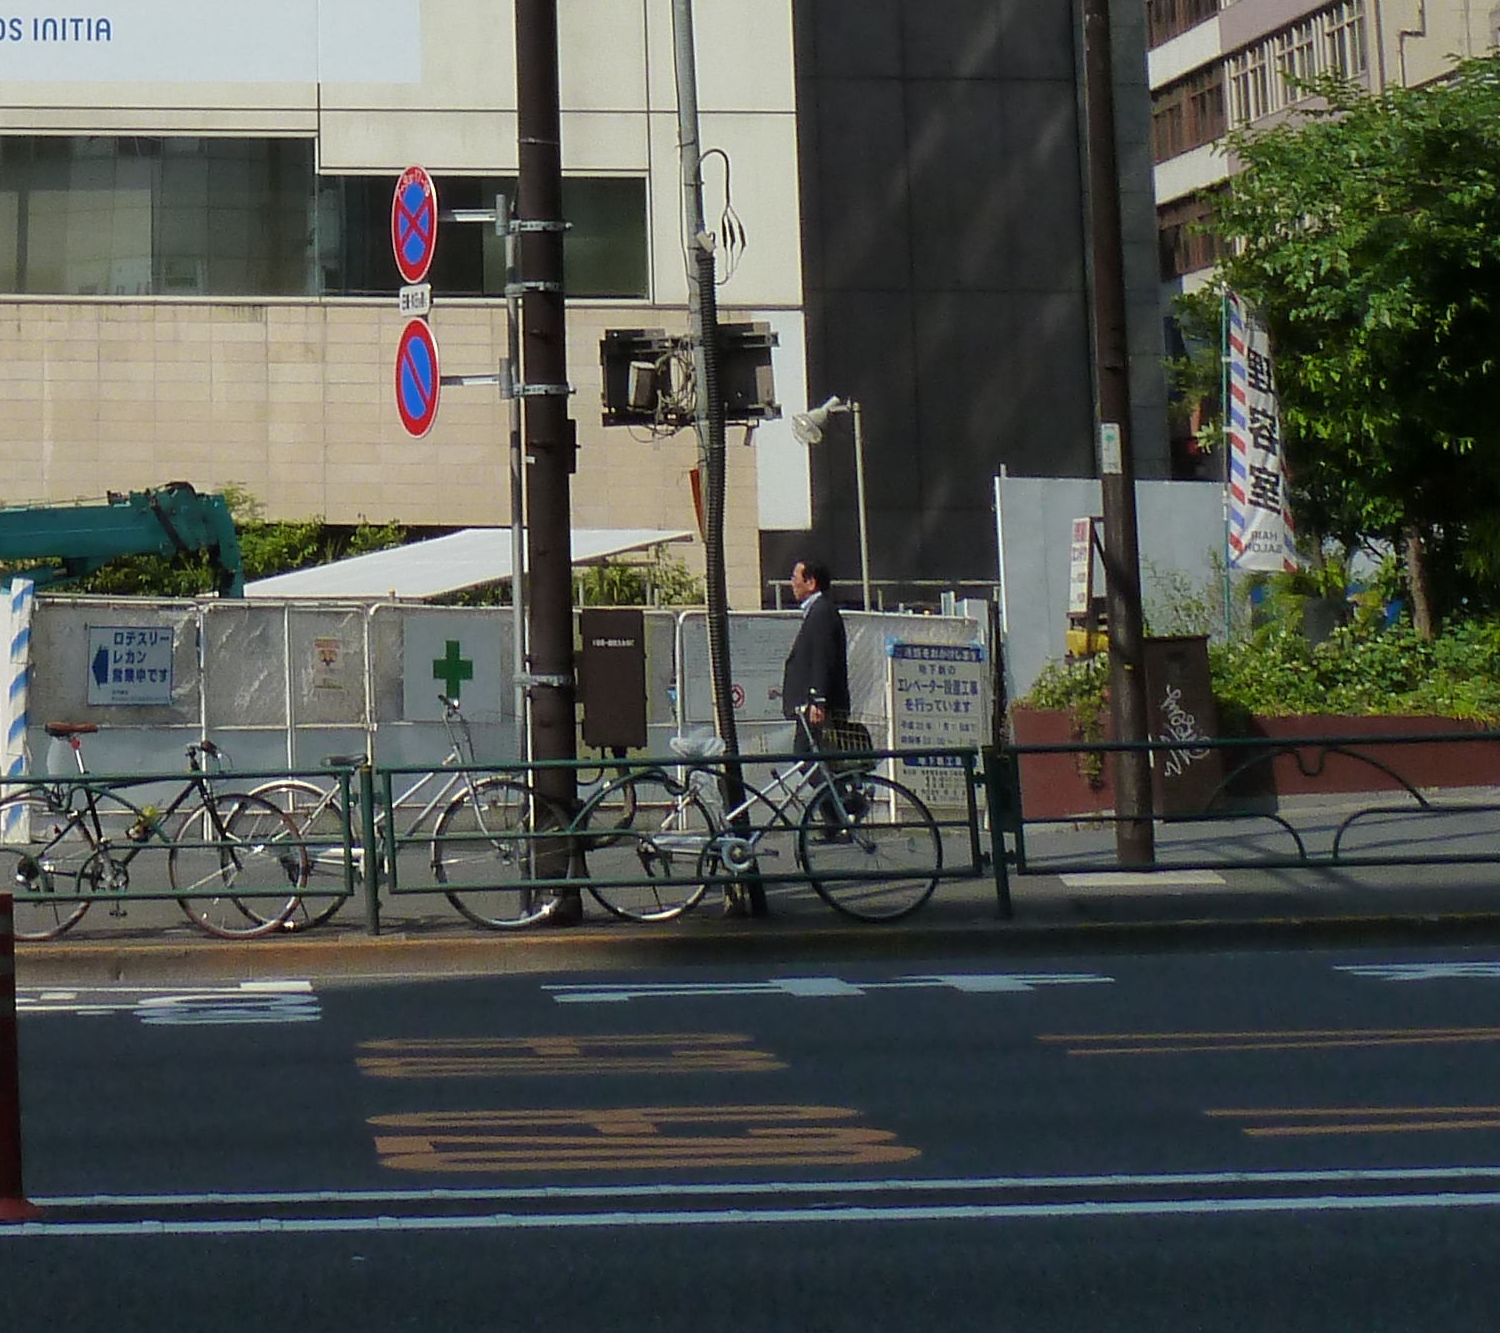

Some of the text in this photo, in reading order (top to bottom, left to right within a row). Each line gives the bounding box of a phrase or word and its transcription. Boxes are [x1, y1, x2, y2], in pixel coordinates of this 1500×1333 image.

[32, 16, 114, 43] INITIA
[114, 632, 170, 645] ロテスリー
[113, 651, 147, 663] レカン
[113, 668, 168, 682] 営業中です
